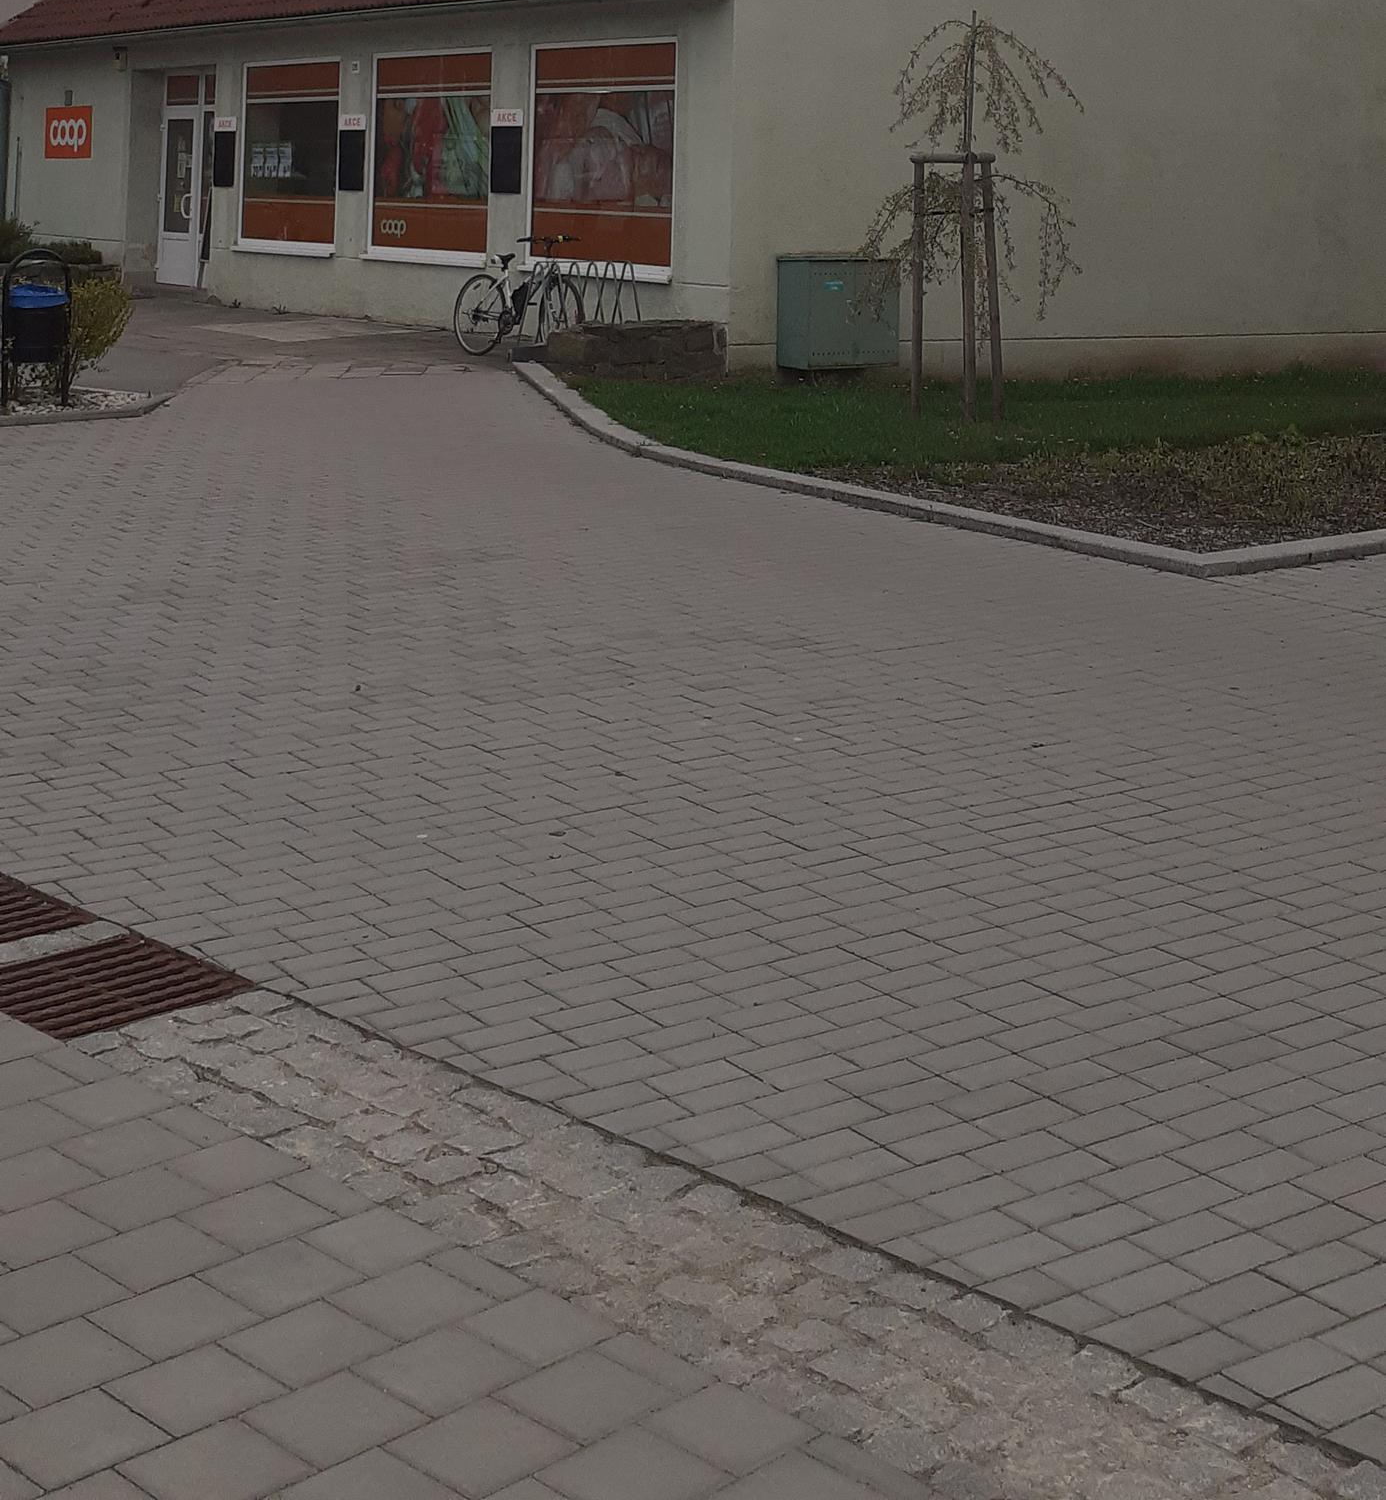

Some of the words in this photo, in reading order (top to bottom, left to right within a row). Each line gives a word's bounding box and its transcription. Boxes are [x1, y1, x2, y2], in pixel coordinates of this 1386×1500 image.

[496, 112, 517, 123] AKCE
[50, 118, 87, 152] coop
[380, 219, 407, 238] coop
